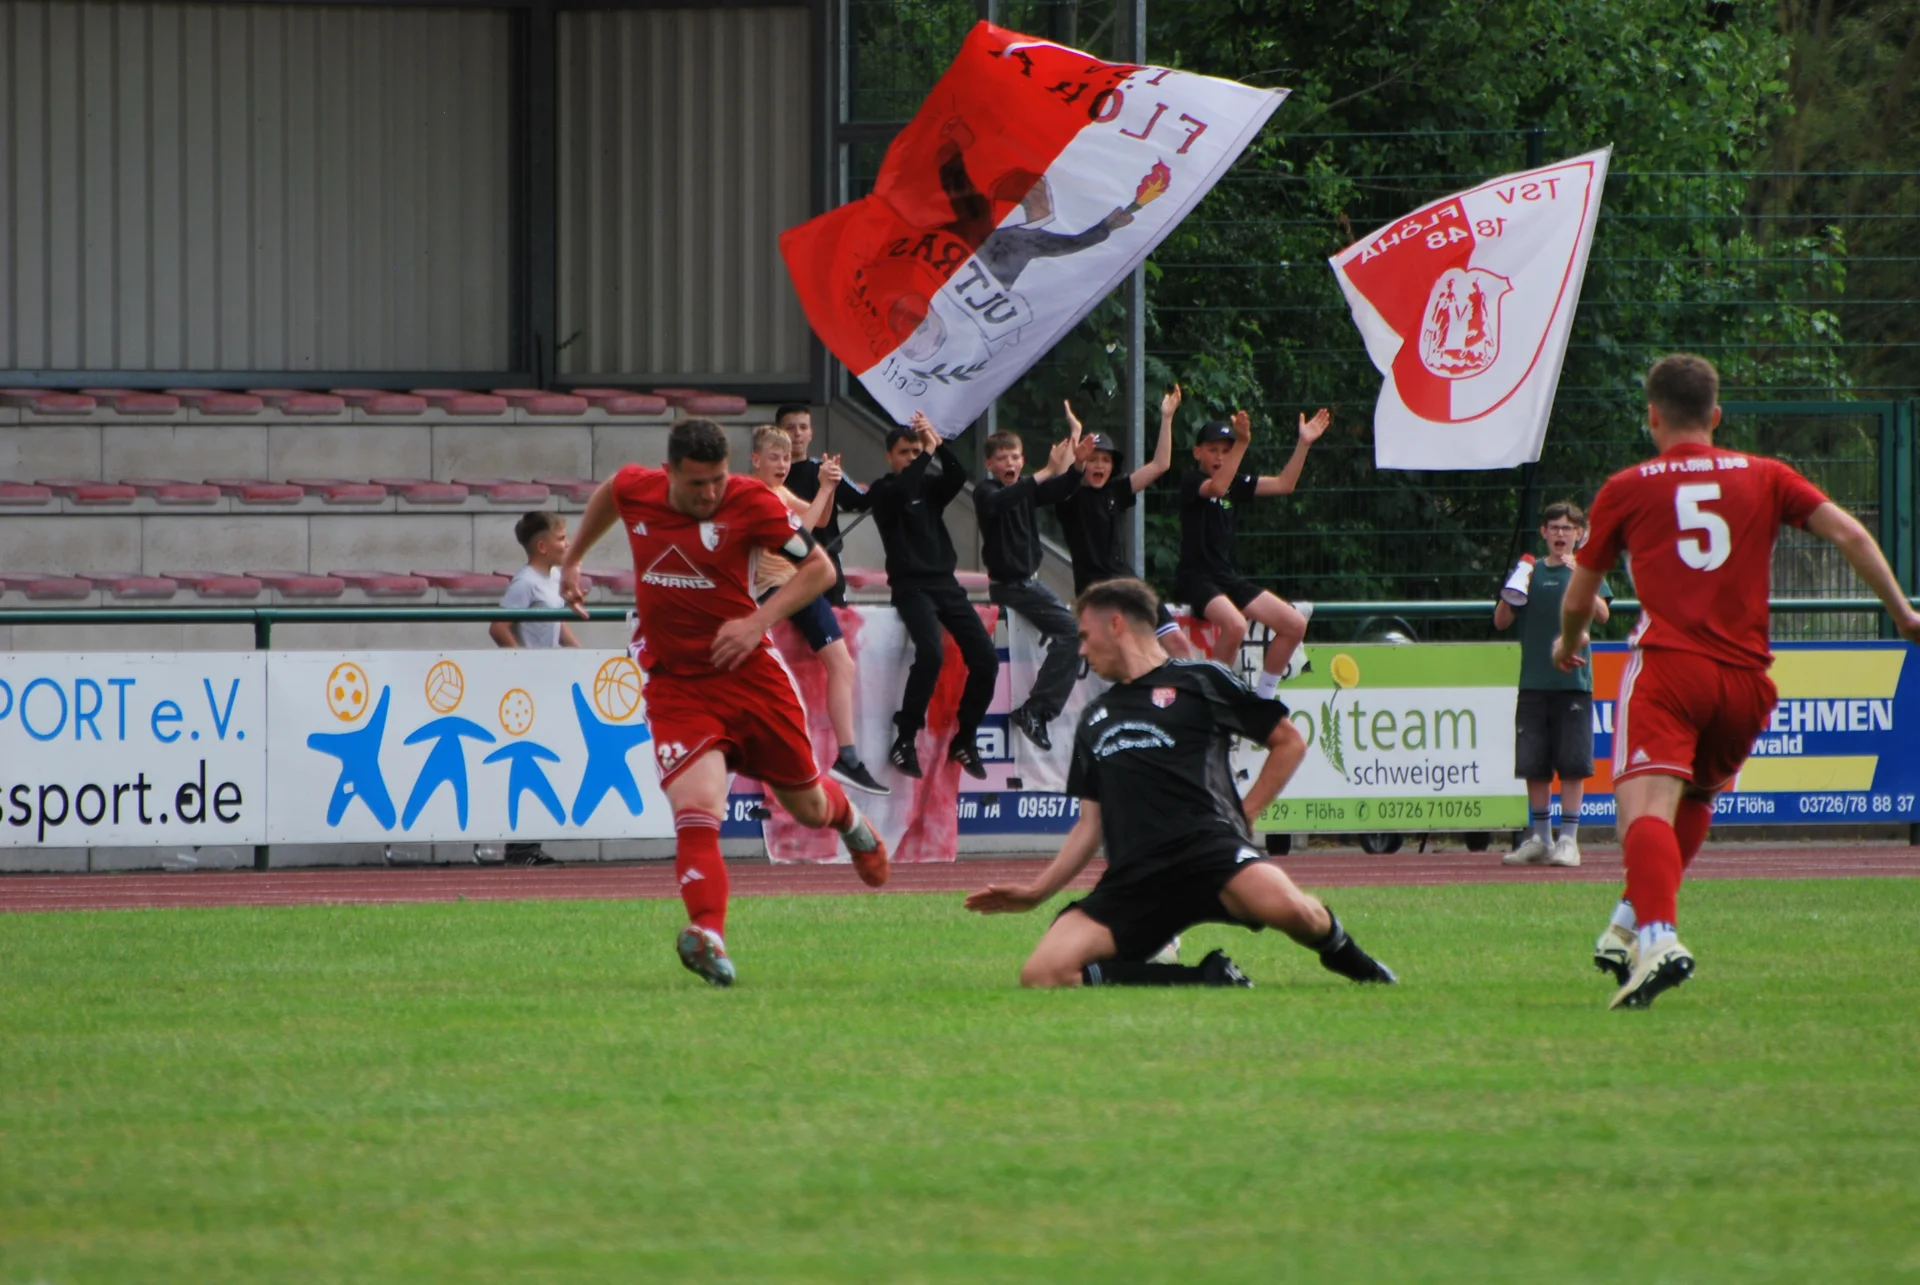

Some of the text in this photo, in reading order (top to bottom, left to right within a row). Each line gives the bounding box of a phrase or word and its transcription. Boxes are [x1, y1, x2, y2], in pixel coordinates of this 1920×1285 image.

[1675, 482, 1732, 572] 5
[151, 677, 246, 744] e.V.
[1354, 759, 1480, 791] schweigert
[0, 759, 243, 843] sport.de
[1018, 797, 1066, 818] 09557
[1272, 804, 1289, 820] 29
[1305, 803, 1345, 820] Flöha
[1378, 803, 1423, 819] 03726
[1428, 801, 1482, 818] 710765
[1737, 796, 1775, 814] Flöha
[1872, 796, 1892, 812] 88
[1897, 796, 1915, 812] 37
